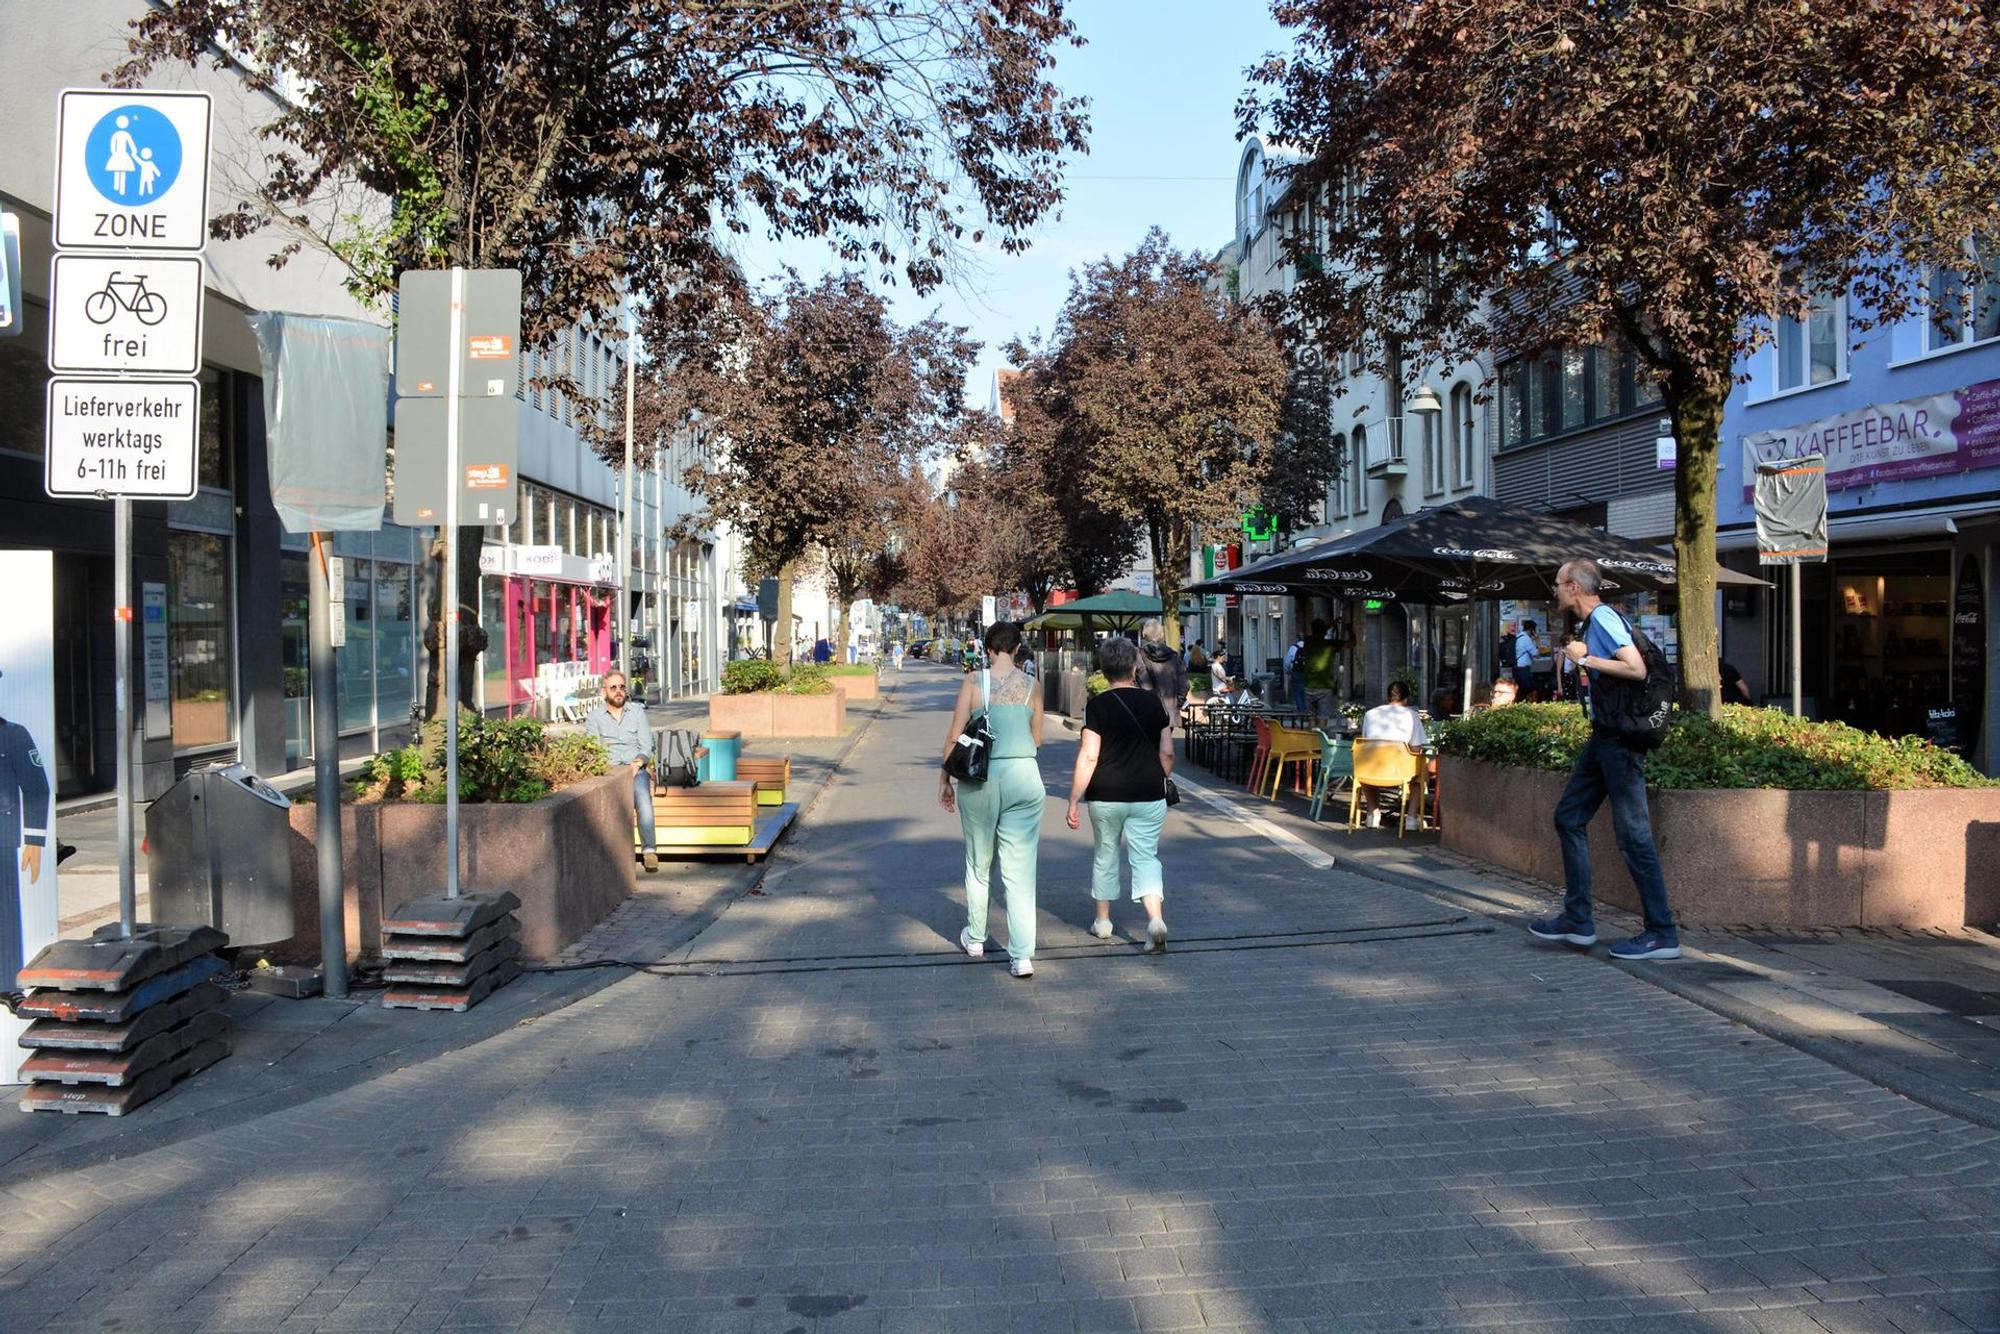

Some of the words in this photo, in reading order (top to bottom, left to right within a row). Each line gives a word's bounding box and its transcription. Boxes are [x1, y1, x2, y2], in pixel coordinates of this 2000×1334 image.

[94, 213, 167, 238] ZONE
[104, 333, 147, 357] frei
[64, 395, 182, 418] Lieferverkehr
[83, 427, 162, 454] werktags
[1795, 410, 1928, 457] KAFFEEBAR
[77, 458, 126, 480] 6-11h
[136, 459, 166, 480] frei
